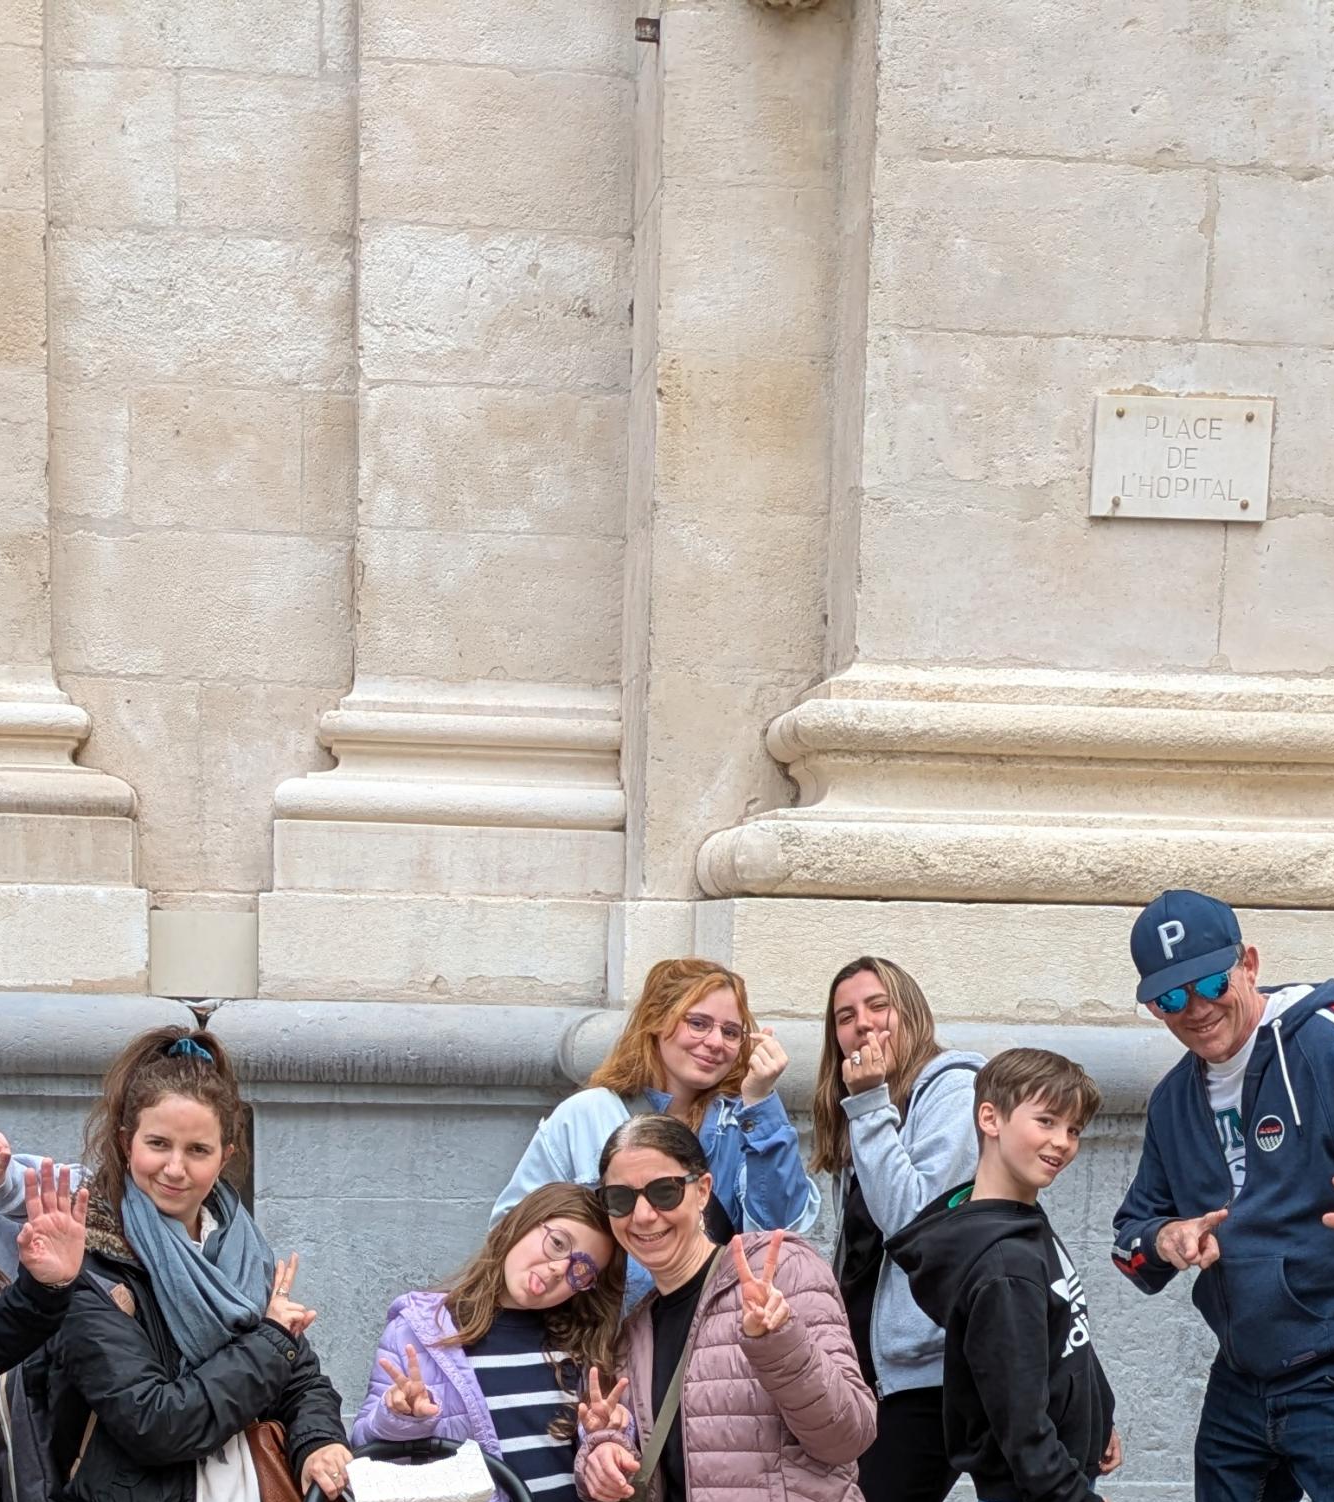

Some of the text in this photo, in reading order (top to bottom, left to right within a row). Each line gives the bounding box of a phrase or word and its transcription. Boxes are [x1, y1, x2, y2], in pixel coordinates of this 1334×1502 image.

[1144, 415, 1224, 441] PLACE
[1166, 446, 1199, 470] DE
[1120, 473, 1240, 502] L'HOPITAL
[1157, 920, 1186, 960] P
